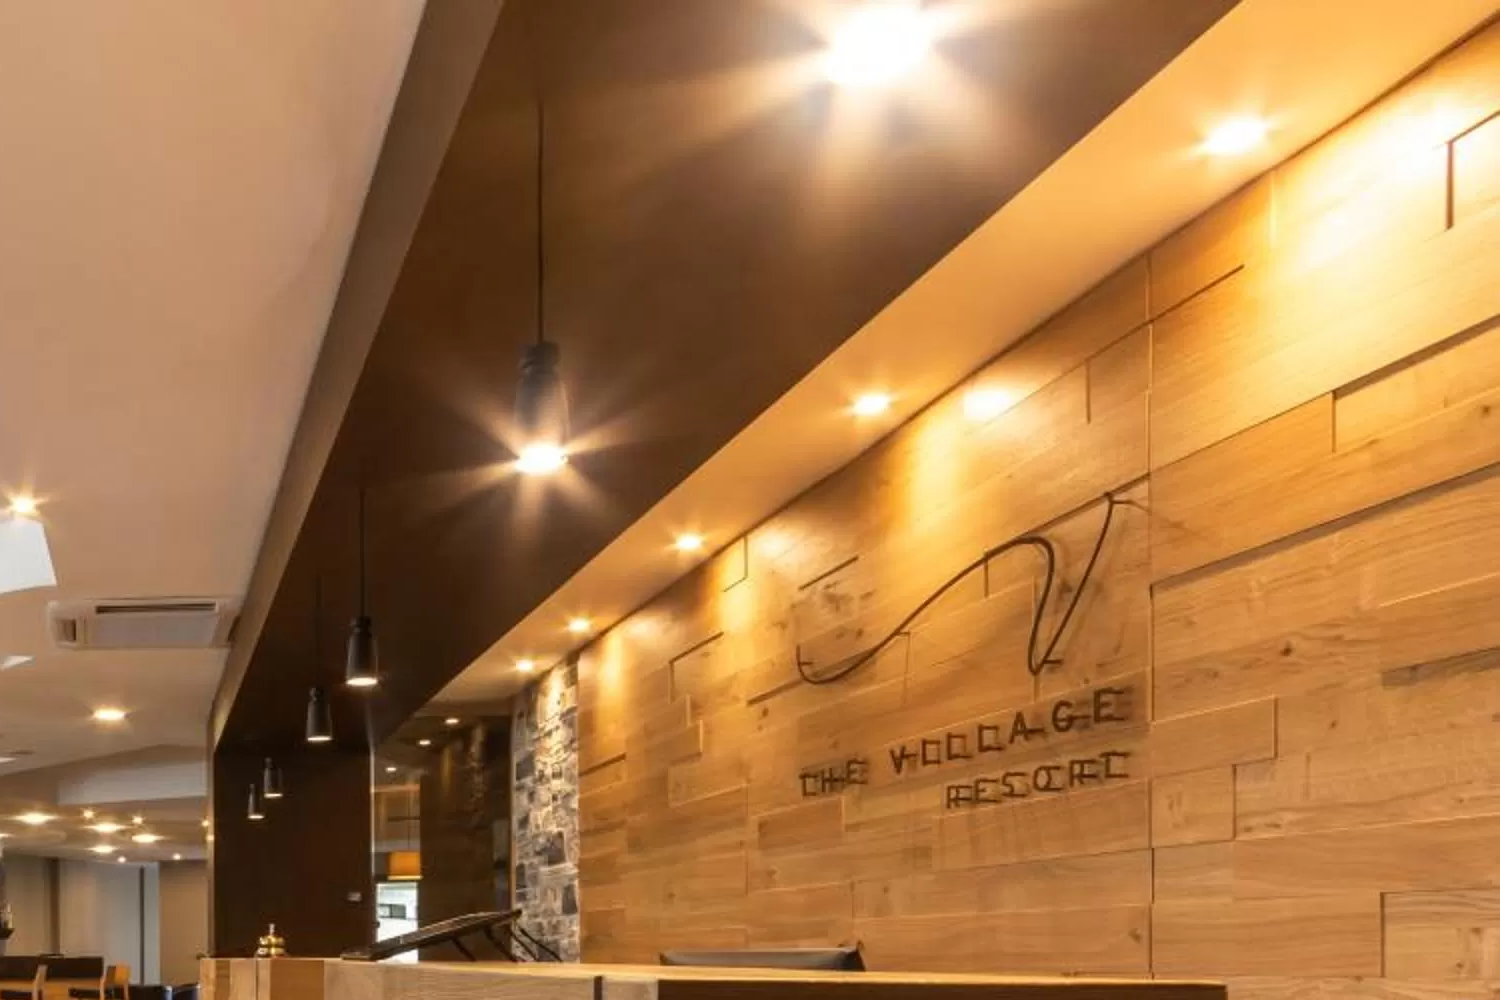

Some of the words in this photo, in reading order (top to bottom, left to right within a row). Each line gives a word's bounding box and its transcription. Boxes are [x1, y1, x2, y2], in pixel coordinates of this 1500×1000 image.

[799, 758, 868, 797] THE
[889, 687, 1132, 774] VILLAGE
[946, 751, 1131, 809] RESORT
